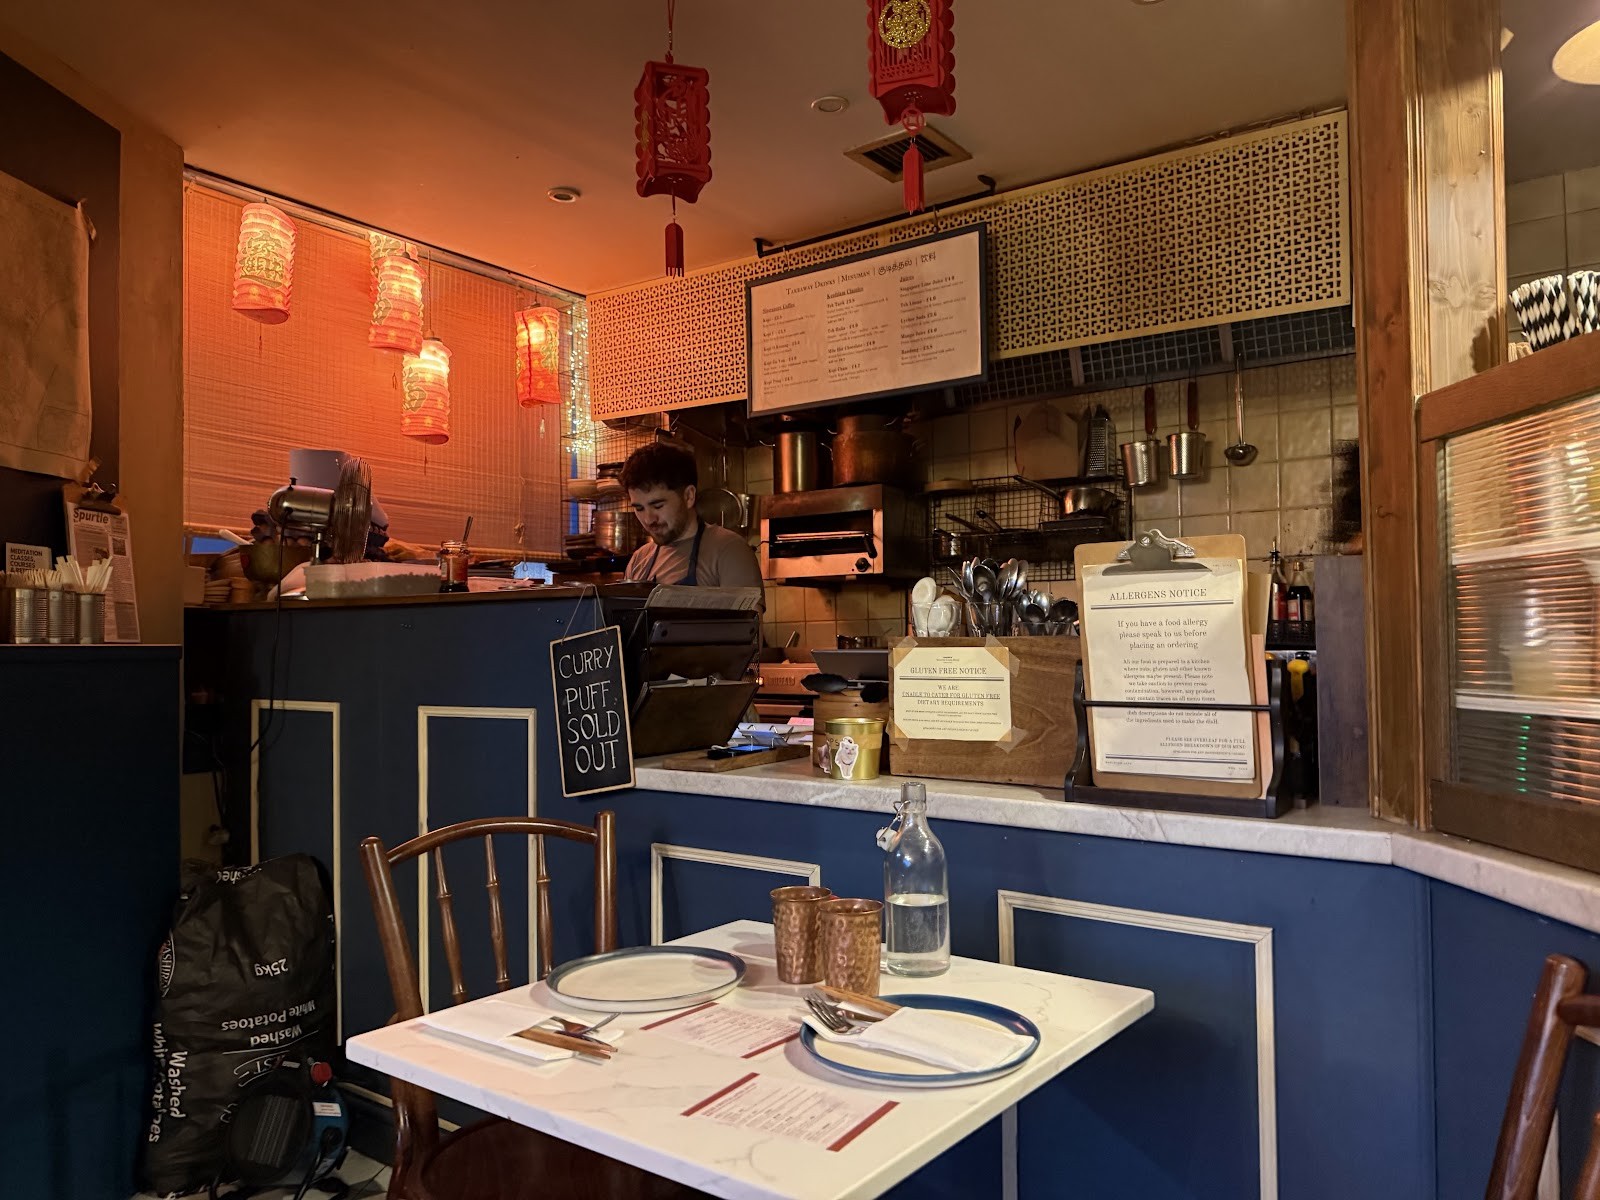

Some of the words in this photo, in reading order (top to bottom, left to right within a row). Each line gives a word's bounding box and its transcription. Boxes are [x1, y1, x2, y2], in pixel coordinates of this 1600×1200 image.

[815, 280, 835, 288] DRINKS
[74, 508, 108, 524] Spurtle
[11, 548, 42, 556] MEDITATION
[1110, 590, 1167, 600] ALLERGENS
[1170, 588, 1207, 598] NOTICE
[1119, 631, 1140, 640] please
[1142, 631, 1162, 639] speak
[1130, 642, 1154, 650] placing
[559, 646, 614, 678] CURRY
[565, 680, 611, 714] PUFF
[567, 710, 620, 744] SOLD
[575, 739, 619, 774] OUT
[254, 958, 288, 976] 25kg
[289, 1000, 316, 1017] White
[221, 1010, 286, 1031] Potatoes
[250, 1024, 302, 1047] Washed
[168, 1051, 188, 1118] Washed
